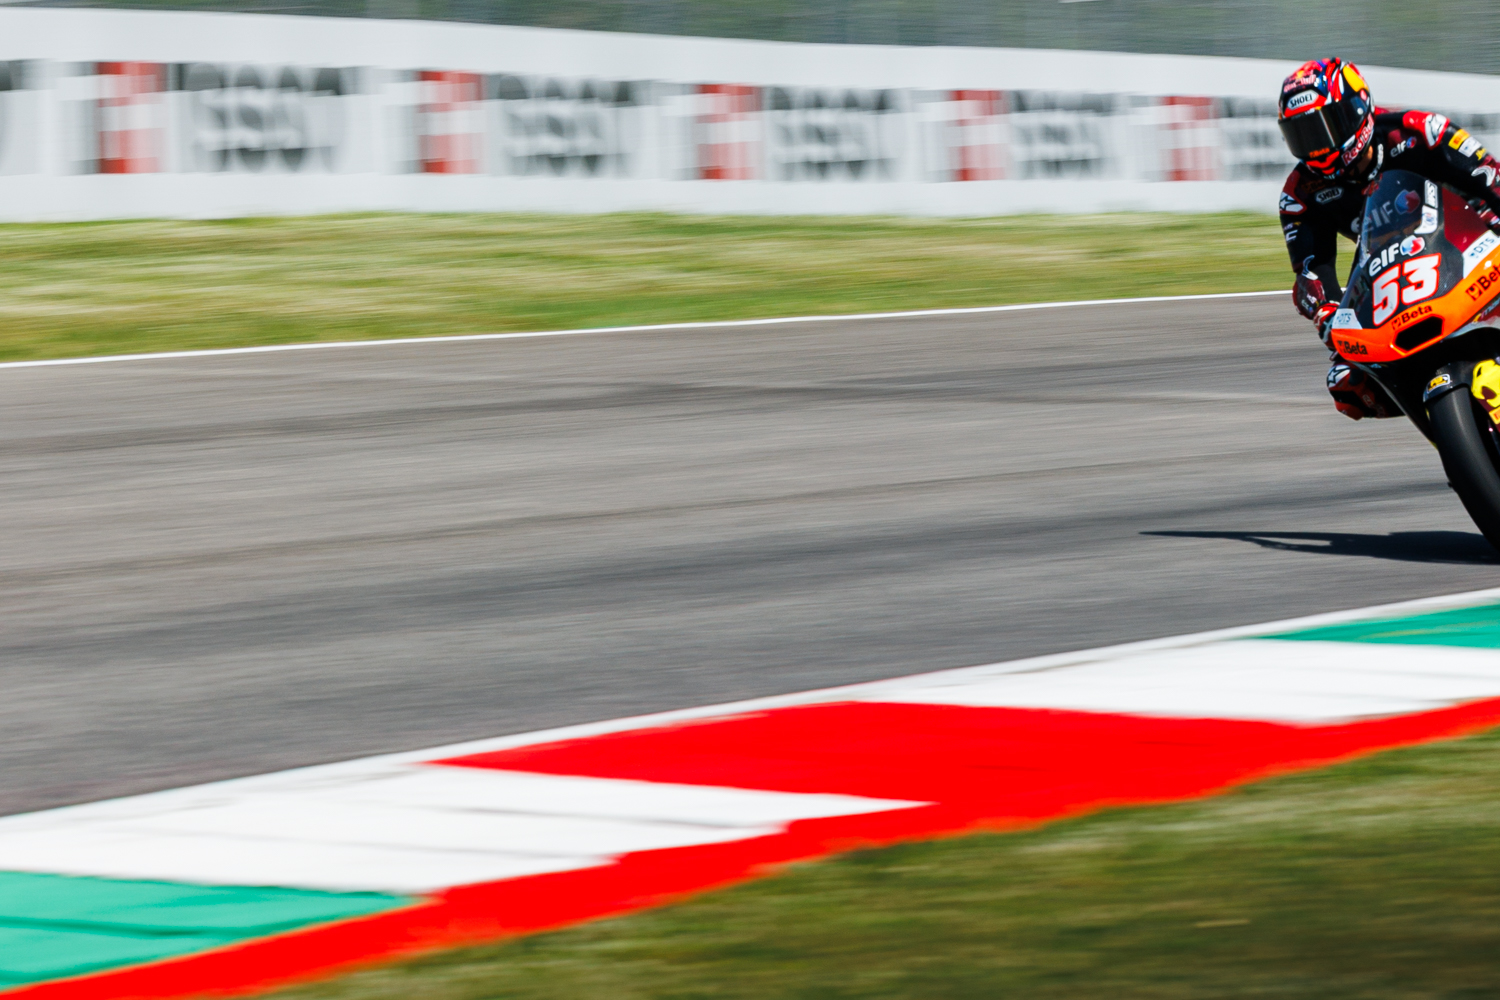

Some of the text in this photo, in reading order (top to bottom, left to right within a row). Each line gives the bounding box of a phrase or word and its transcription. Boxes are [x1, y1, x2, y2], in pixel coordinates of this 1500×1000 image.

[1289, 93, 1313, 108] SHOEI
[1341, 137, 1364, 167] Red
[1390, 140, 1407, 157] elf
[1318, 187, 1340, 201] SHOEI
[1369, 243, 1399, 277] elf
[1373, 253, 1442, 327] 53
[1401, 305, 1433, 323] Beta
[1343, 340, 1368, 355] Beta
